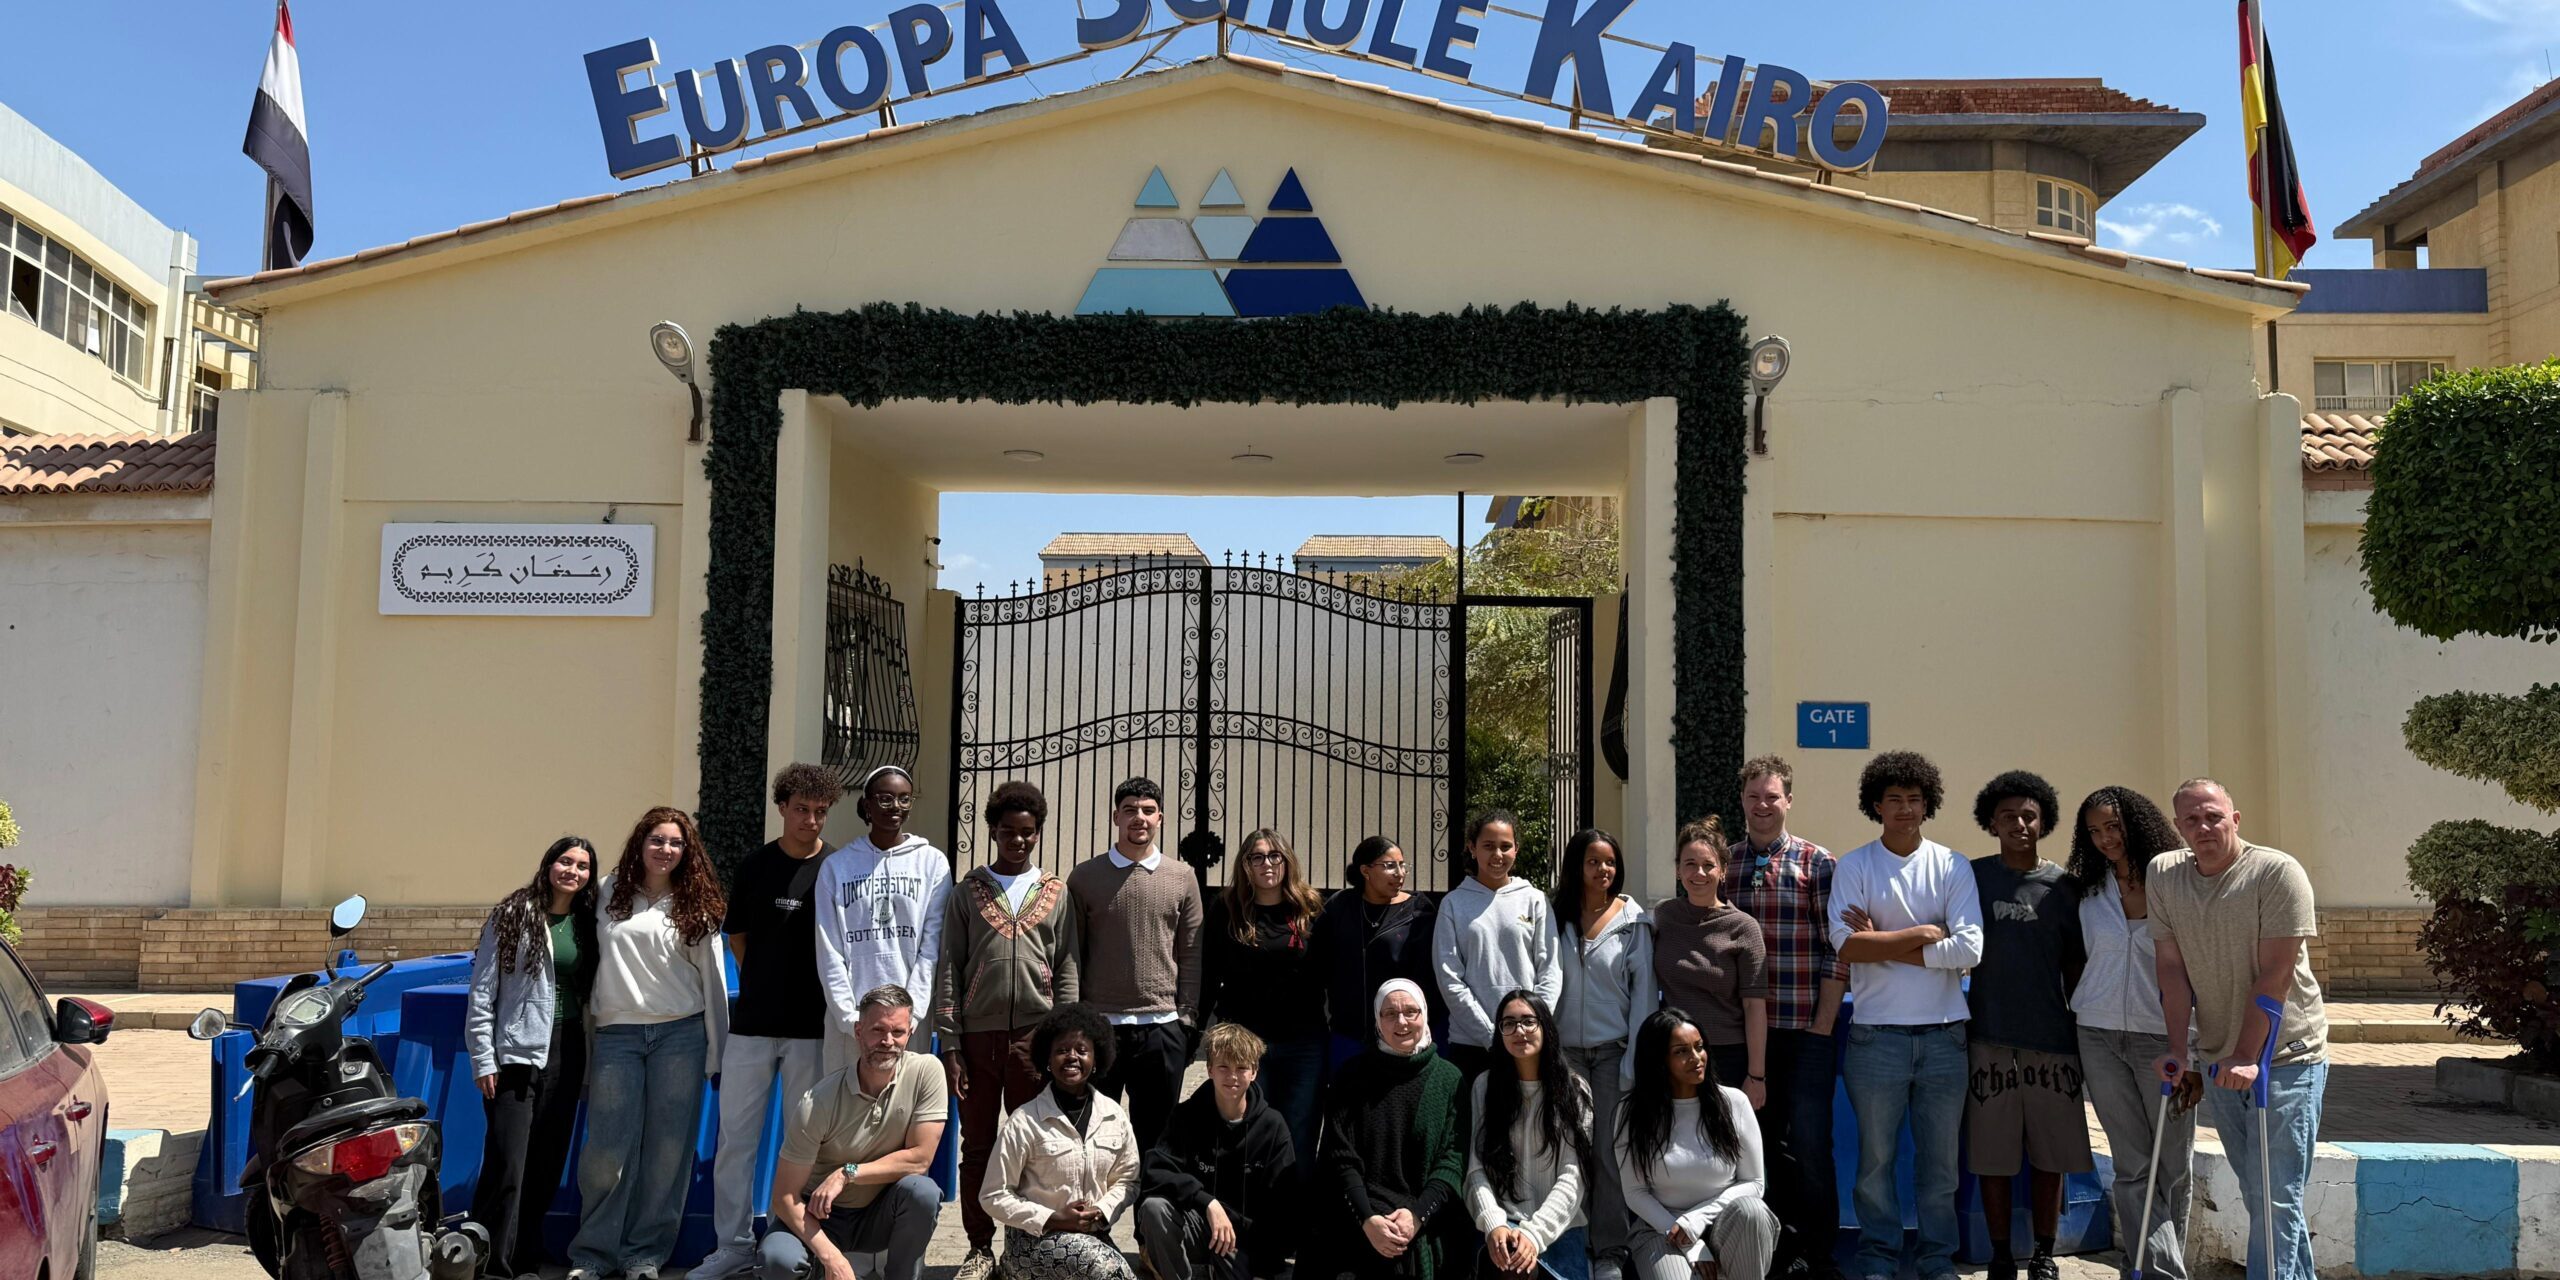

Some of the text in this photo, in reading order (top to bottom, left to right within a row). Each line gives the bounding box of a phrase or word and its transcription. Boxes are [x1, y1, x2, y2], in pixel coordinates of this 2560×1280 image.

[583, 0, 1031, 180] EUROPA
[1523, 0, 1889, 173] KAIRO
[1809, 708, 1856, 724] GATE
[1828, 729, 1837, 743] 1
